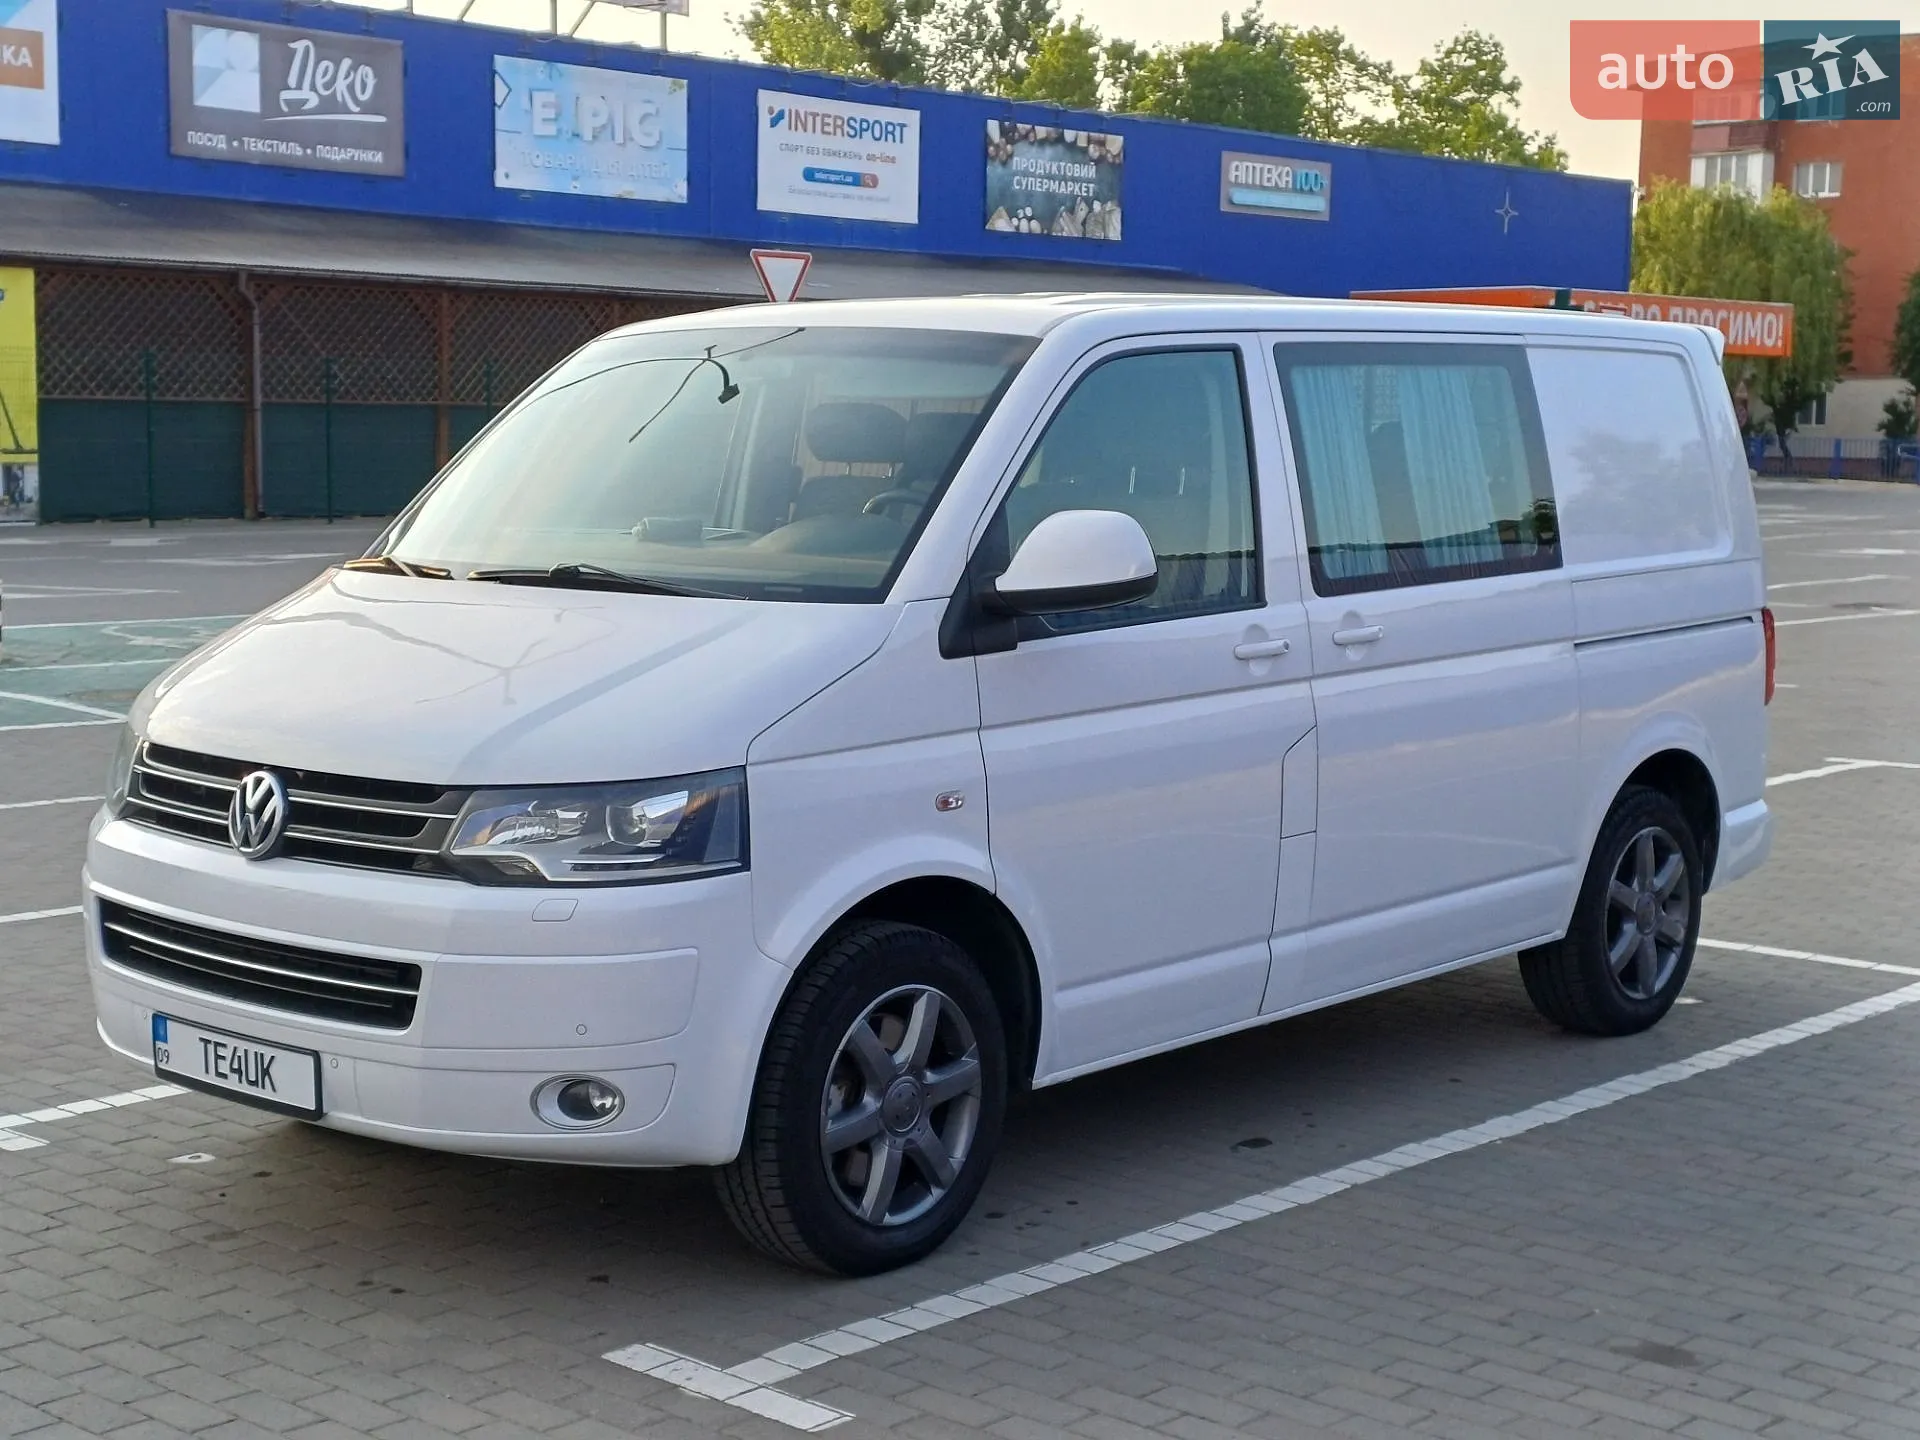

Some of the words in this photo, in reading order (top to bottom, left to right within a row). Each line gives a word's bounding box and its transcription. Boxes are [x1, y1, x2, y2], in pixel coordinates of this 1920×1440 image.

[0, 44, 33, 68] КА
[279, 39, 377, 113] Деко
[788, 108, 908, 144] INTERSPORT
[187, 131, 227, 149] ПОСУД
[242, 137, 303, 156] ТЕКСТИЛЬ
[315, 145, 384, 163] ПОДАРУНКИ
[1012, 157, 1096, 178] ПРОДУКТОВИЙ
[1229, 161, 1292, 189] АПТЕКА
[1013, 176, 1095, 197] СУПЕРМАРКЕТ
[157, 1047, 170, 1064] 09
[199, 1037, 276, 1093] TE4UK
